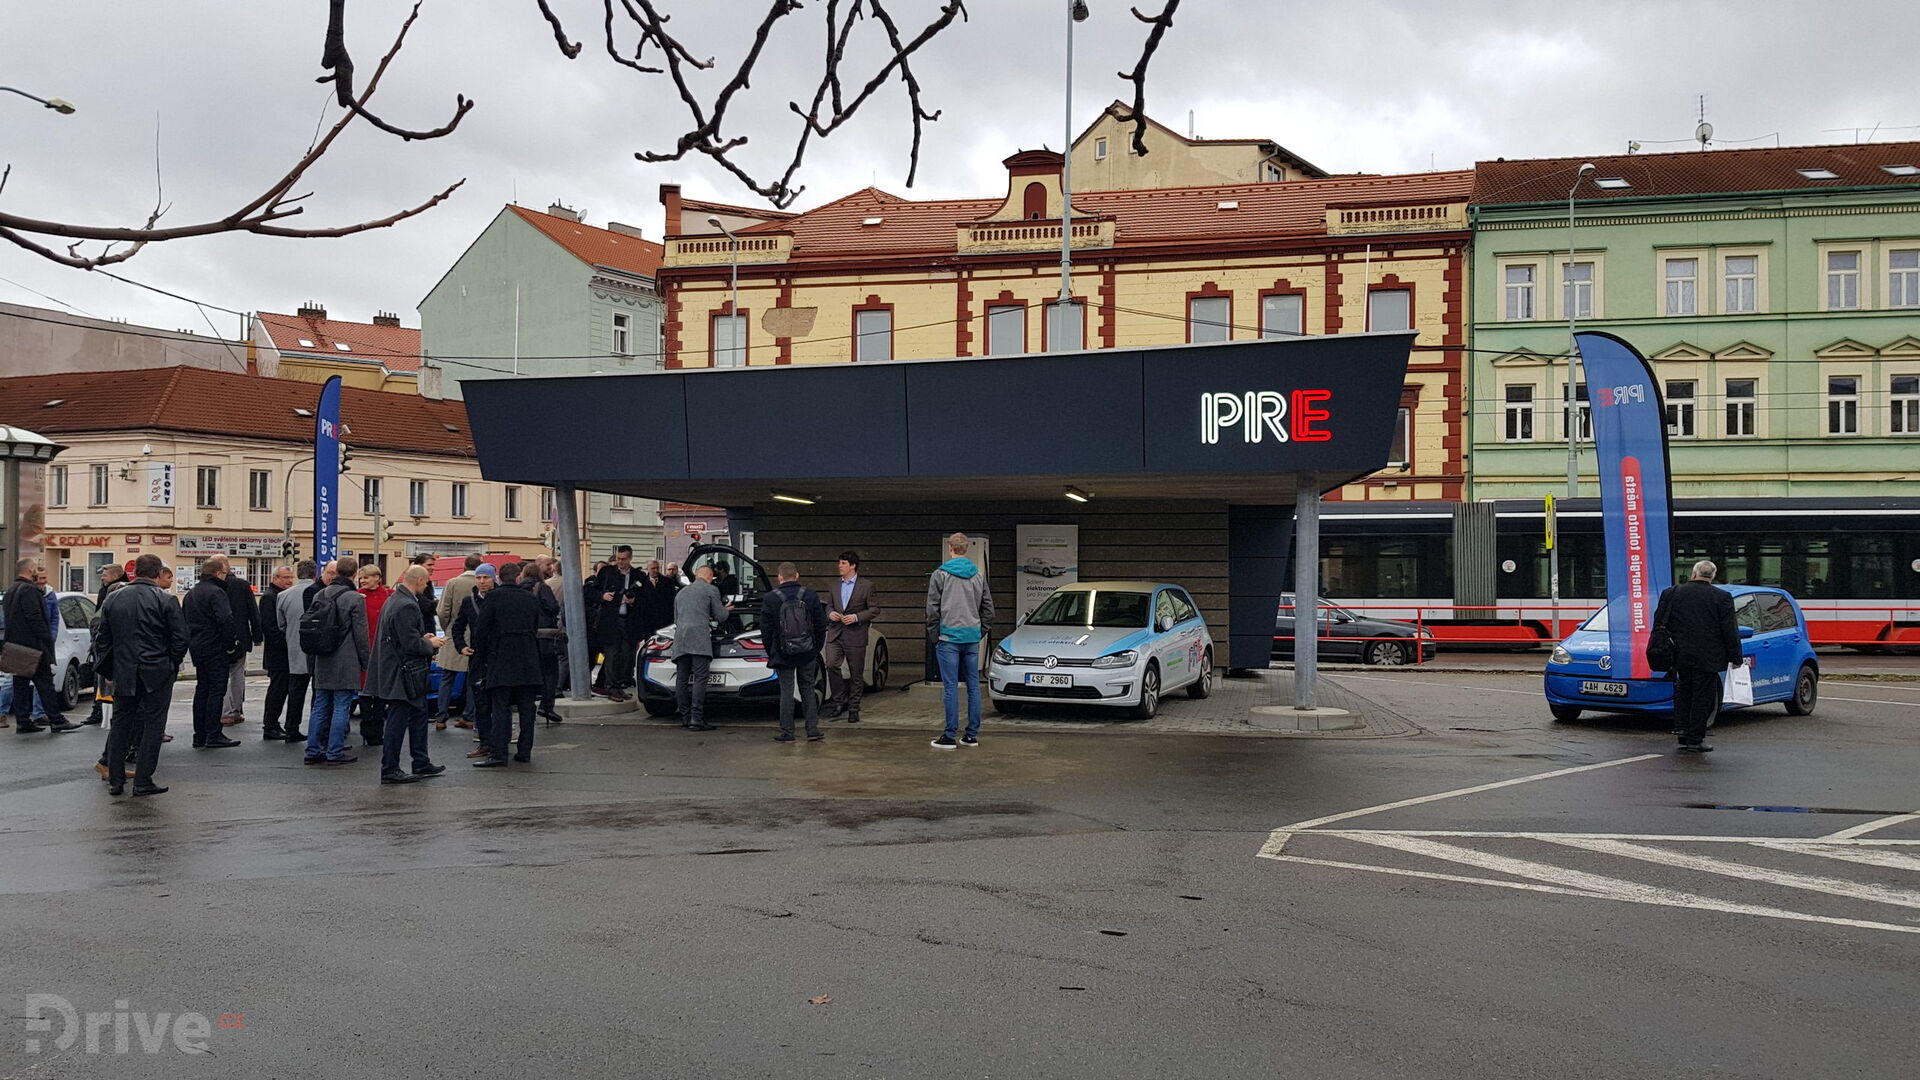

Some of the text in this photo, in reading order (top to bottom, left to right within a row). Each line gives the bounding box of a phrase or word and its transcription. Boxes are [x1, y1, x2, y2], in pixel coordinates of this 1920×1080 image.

[1201, 389, 1332, 444] PRE
[321, 418, 337, 440] PRE
[319, 485, 329, 555] energie
[59, 535, 111, 547] REKLAMY
[1031, 675, 1069, 685] 4SF 2960
[1584, 681, 1624, 693] 4AH 4629
